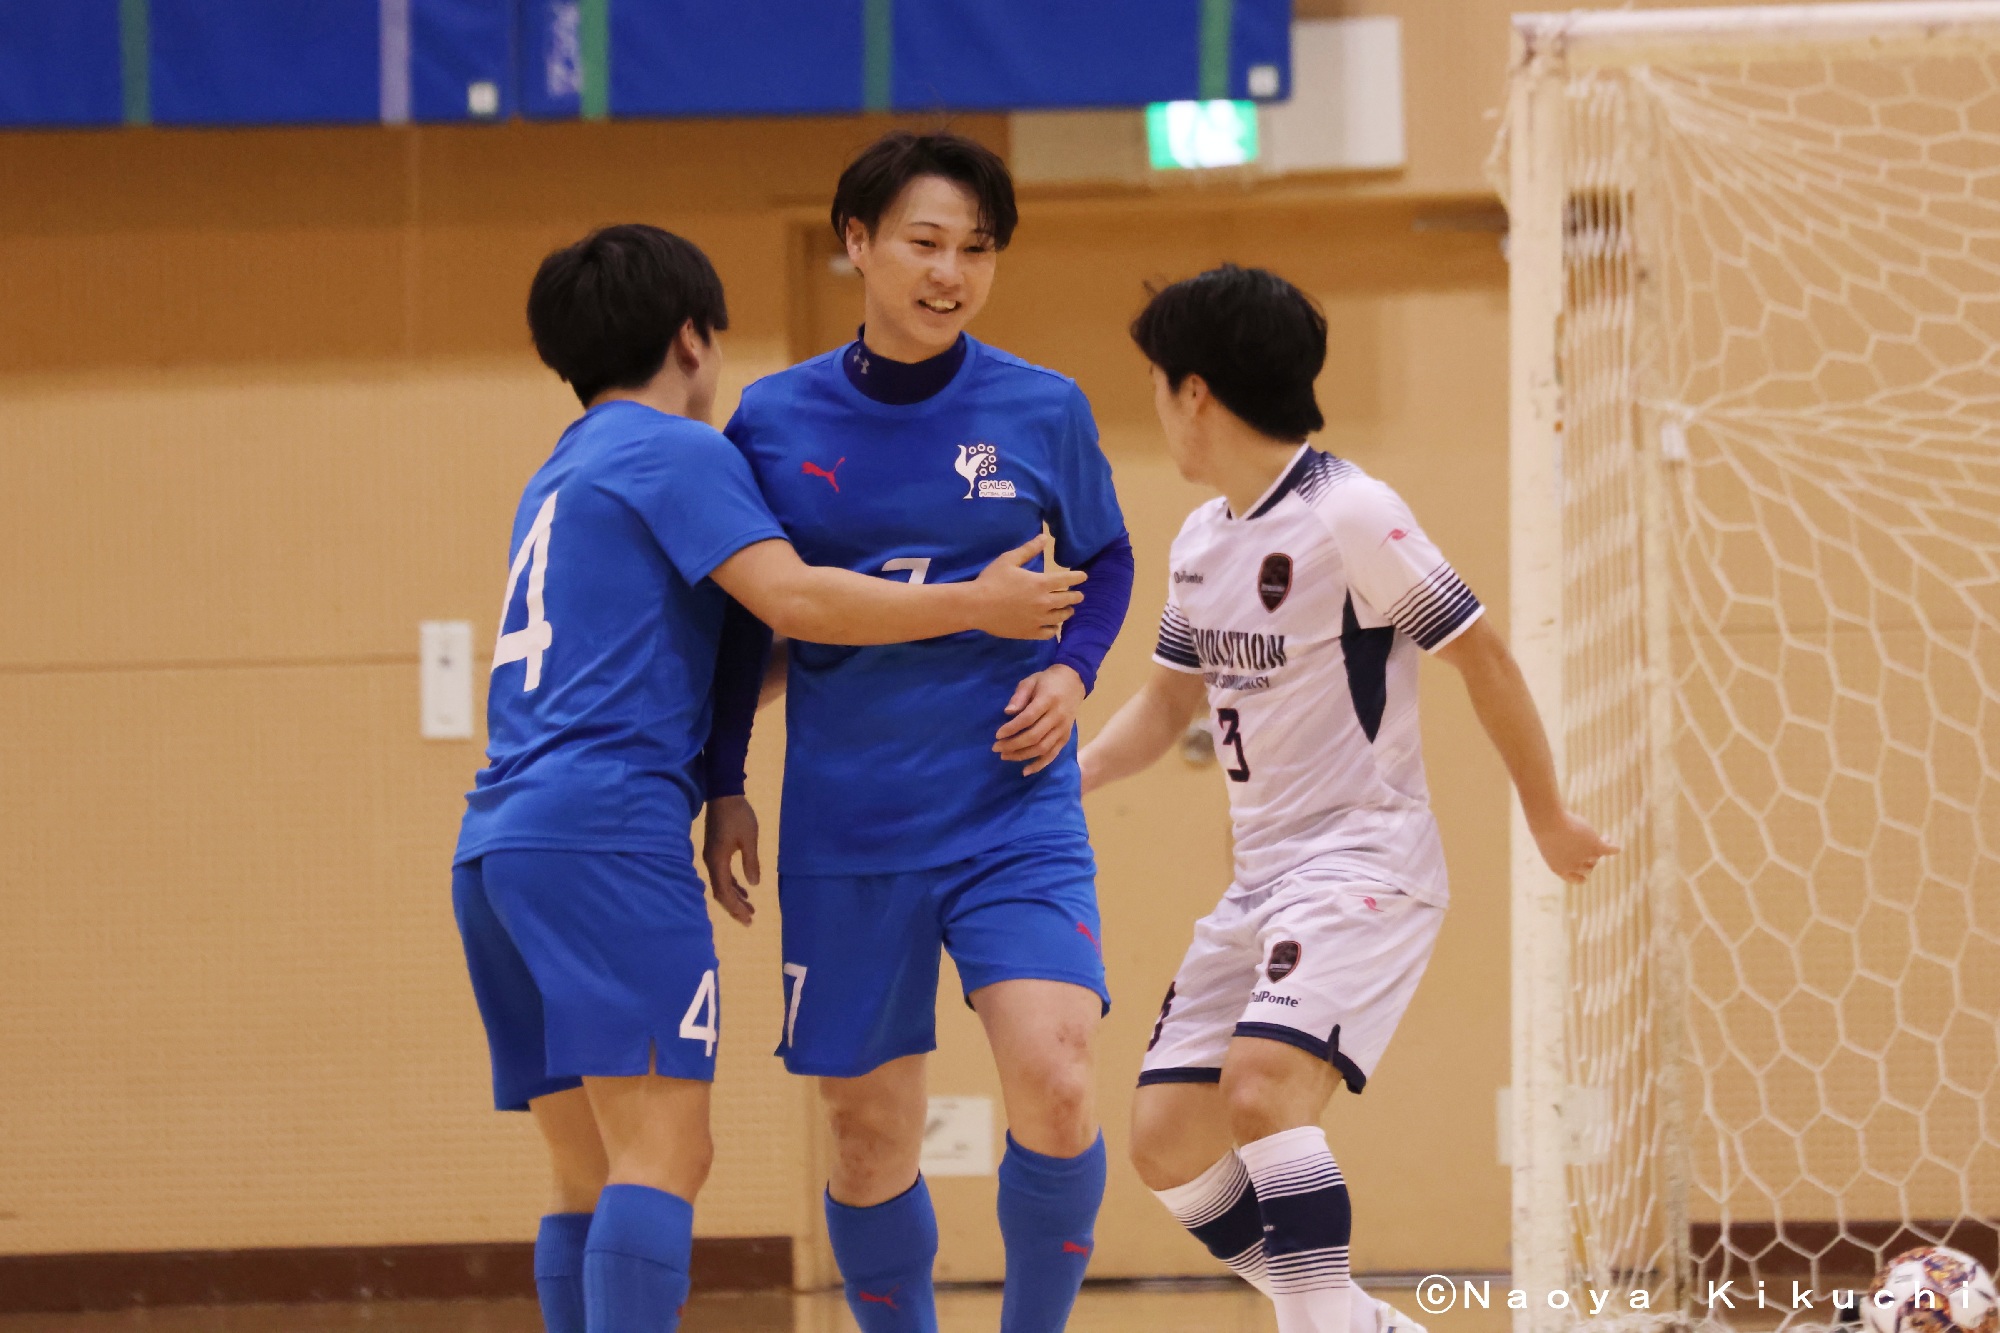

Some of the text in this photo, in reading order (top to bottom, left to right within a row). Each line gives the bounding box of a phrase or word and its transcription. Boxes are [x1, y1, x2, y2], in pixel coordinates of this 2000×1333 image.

[979, 481, 1013, 490] GALSA
[491, 490, 558, 692] 4
[1192, 628, 1287, 670] VOLUTION
[1216, 707, 1250, 782] 3
[679, 969, 717, 1057] 4
[783, 962, 808, 1049] 7
